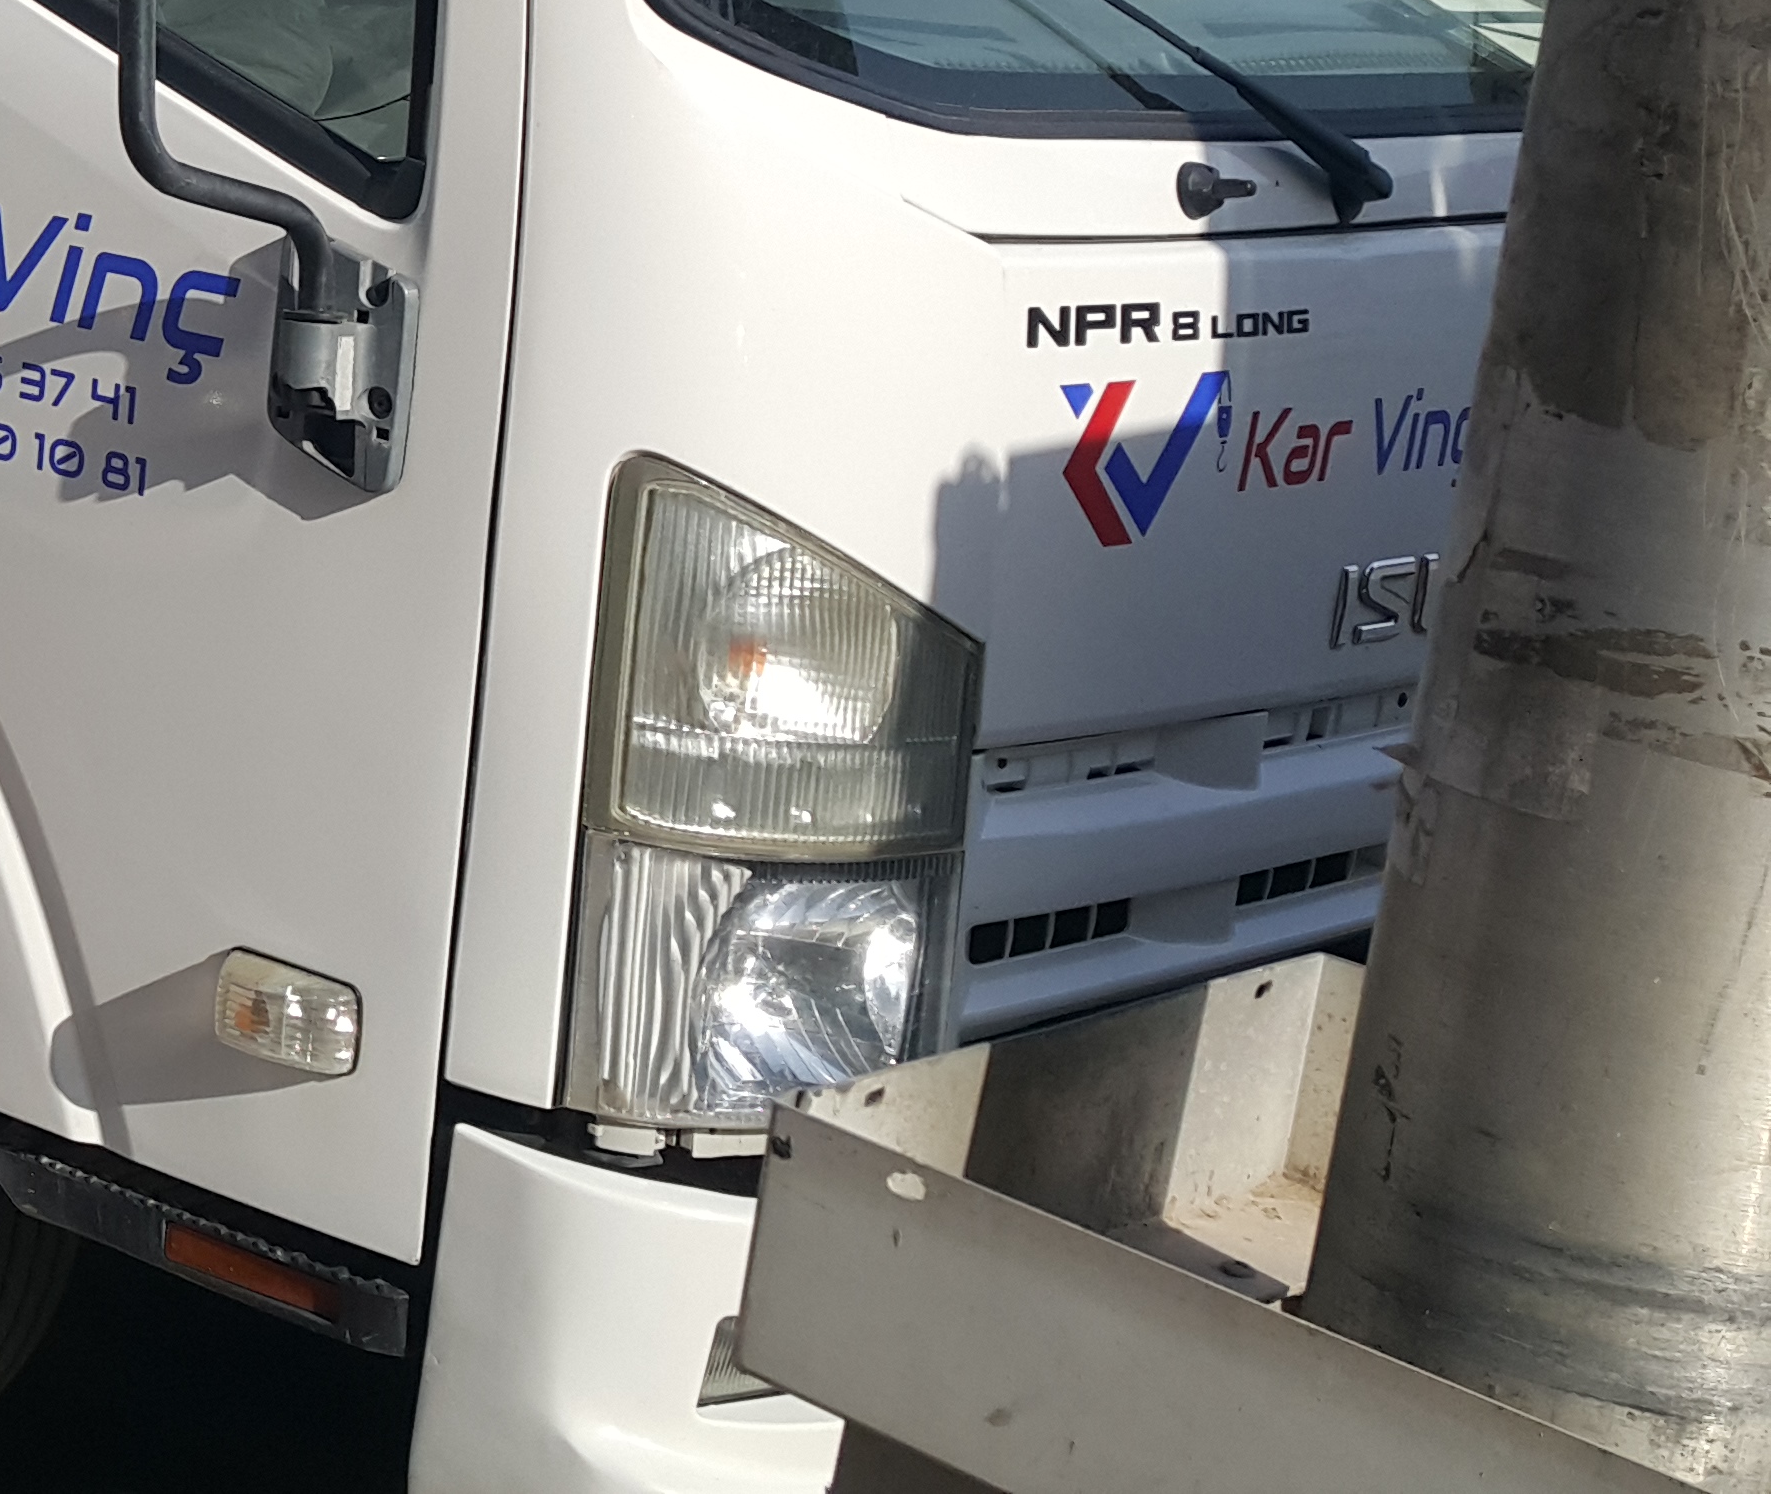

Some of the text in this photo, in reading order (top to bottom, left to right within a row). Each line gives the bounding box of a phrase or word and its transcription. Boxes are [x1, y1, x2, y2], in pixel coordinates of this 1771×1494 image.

[1026, 302, 1310, 348] NPR 8 LONG
[19, 362, 75, 407] 37
[91, 378, 136, 425] 41
[34, 432, 85, 478] 10
[101, 451, 147, 497] 81
[1237, 407, 1353, 492] Kar
